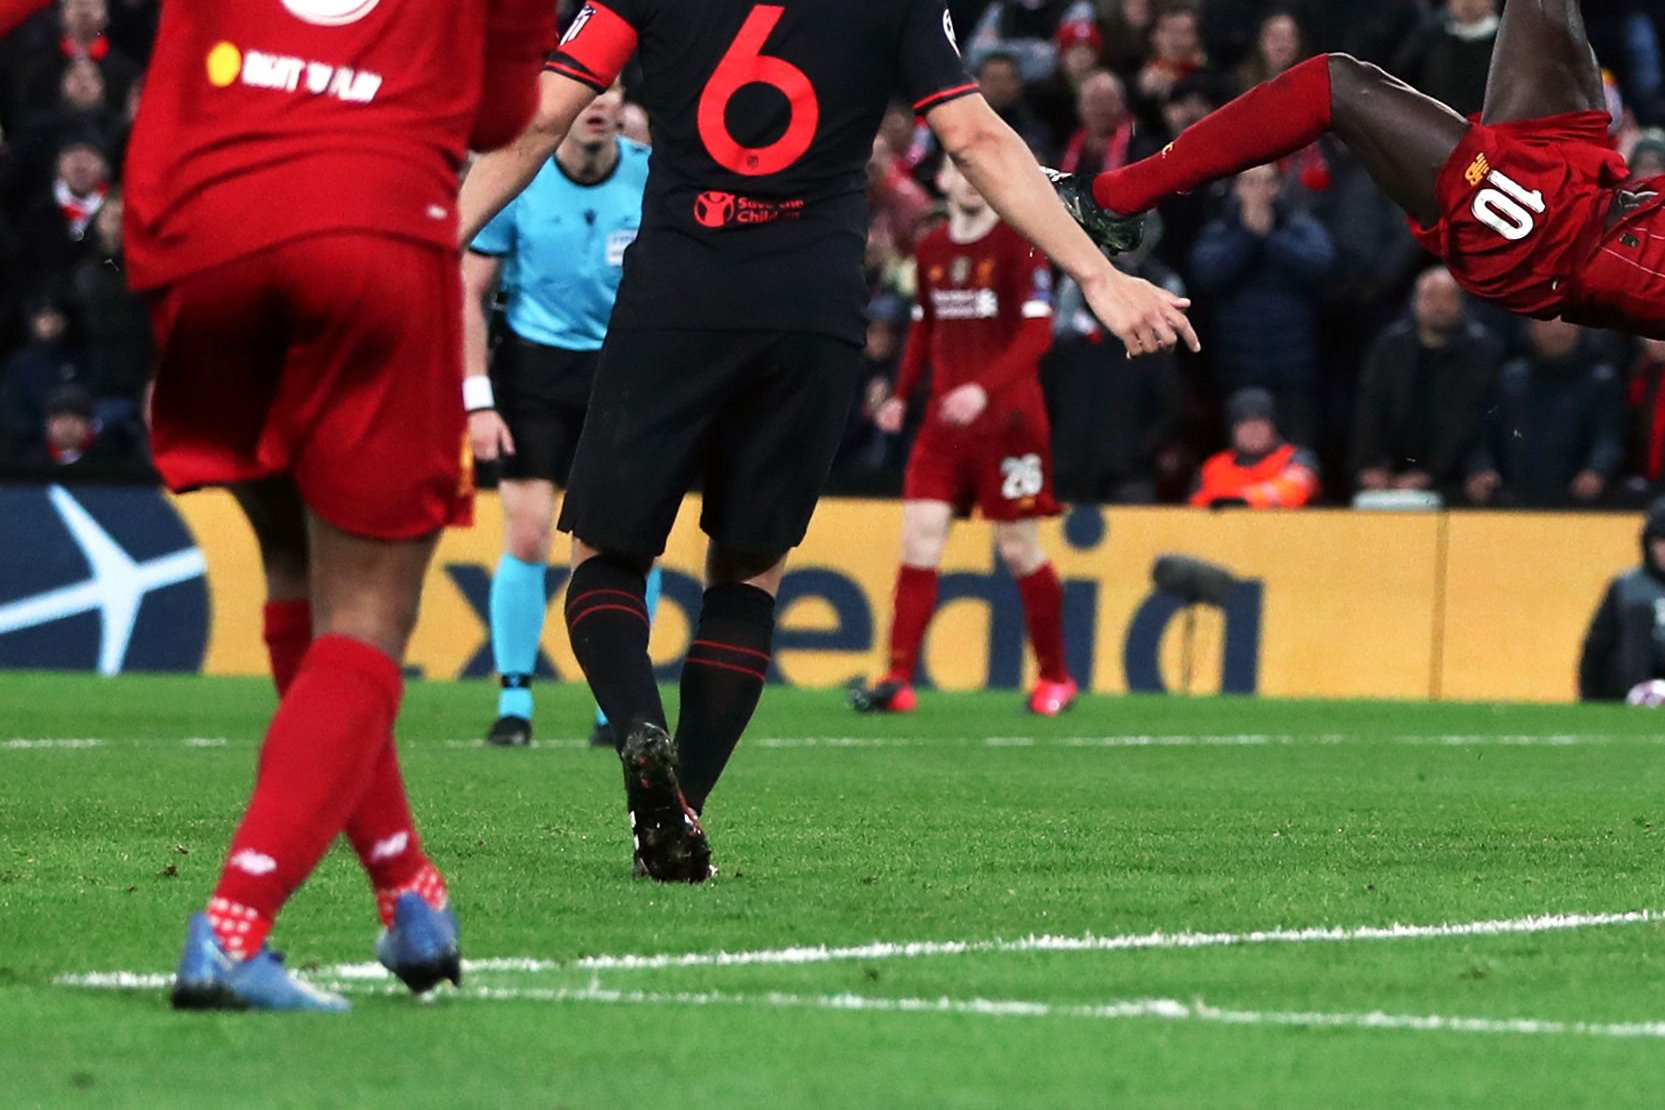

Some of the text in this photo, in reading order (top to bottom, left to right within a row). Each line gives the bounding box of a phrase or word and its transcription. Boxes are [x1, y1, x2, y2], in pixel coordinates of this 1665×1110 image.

[697, 3, 819, 177] 6
[1471, 169, 1546, 240] 10
[1001, 453, 1043, 500] 26
[402, 495, 1264, 693] xedia
